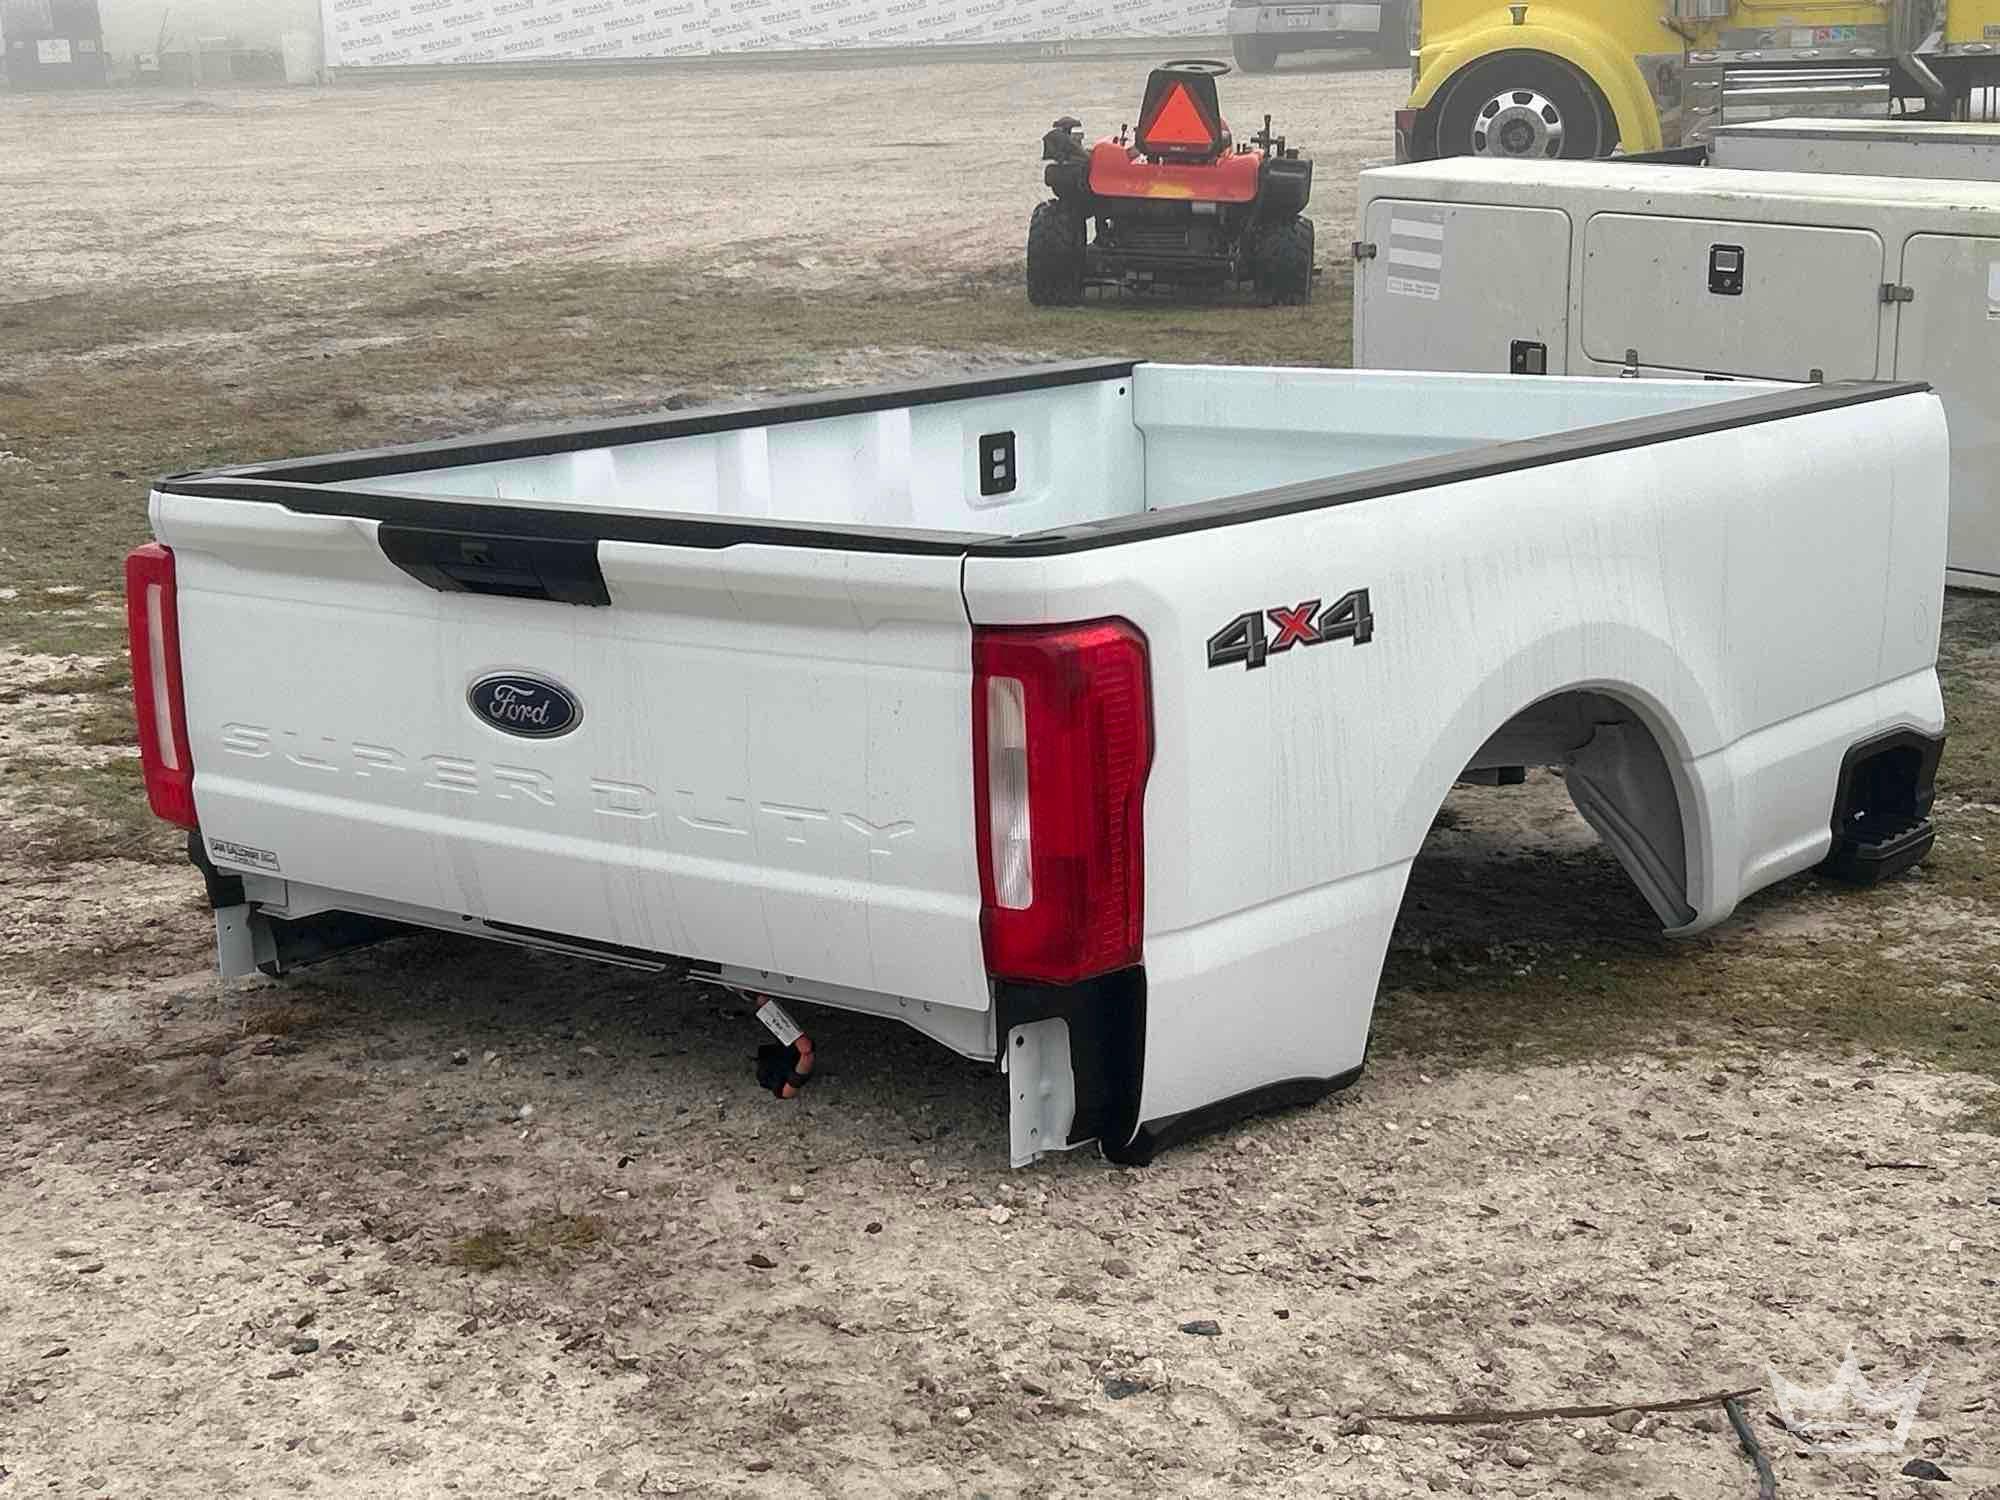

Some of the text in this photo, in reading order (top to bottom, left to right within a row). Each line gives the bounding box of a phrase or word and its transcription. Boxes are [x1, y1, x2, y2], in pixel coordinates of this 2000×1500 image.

[489, 684, 551, 724] Ford
[221, 722, 915, 854] SUPER DUTY
